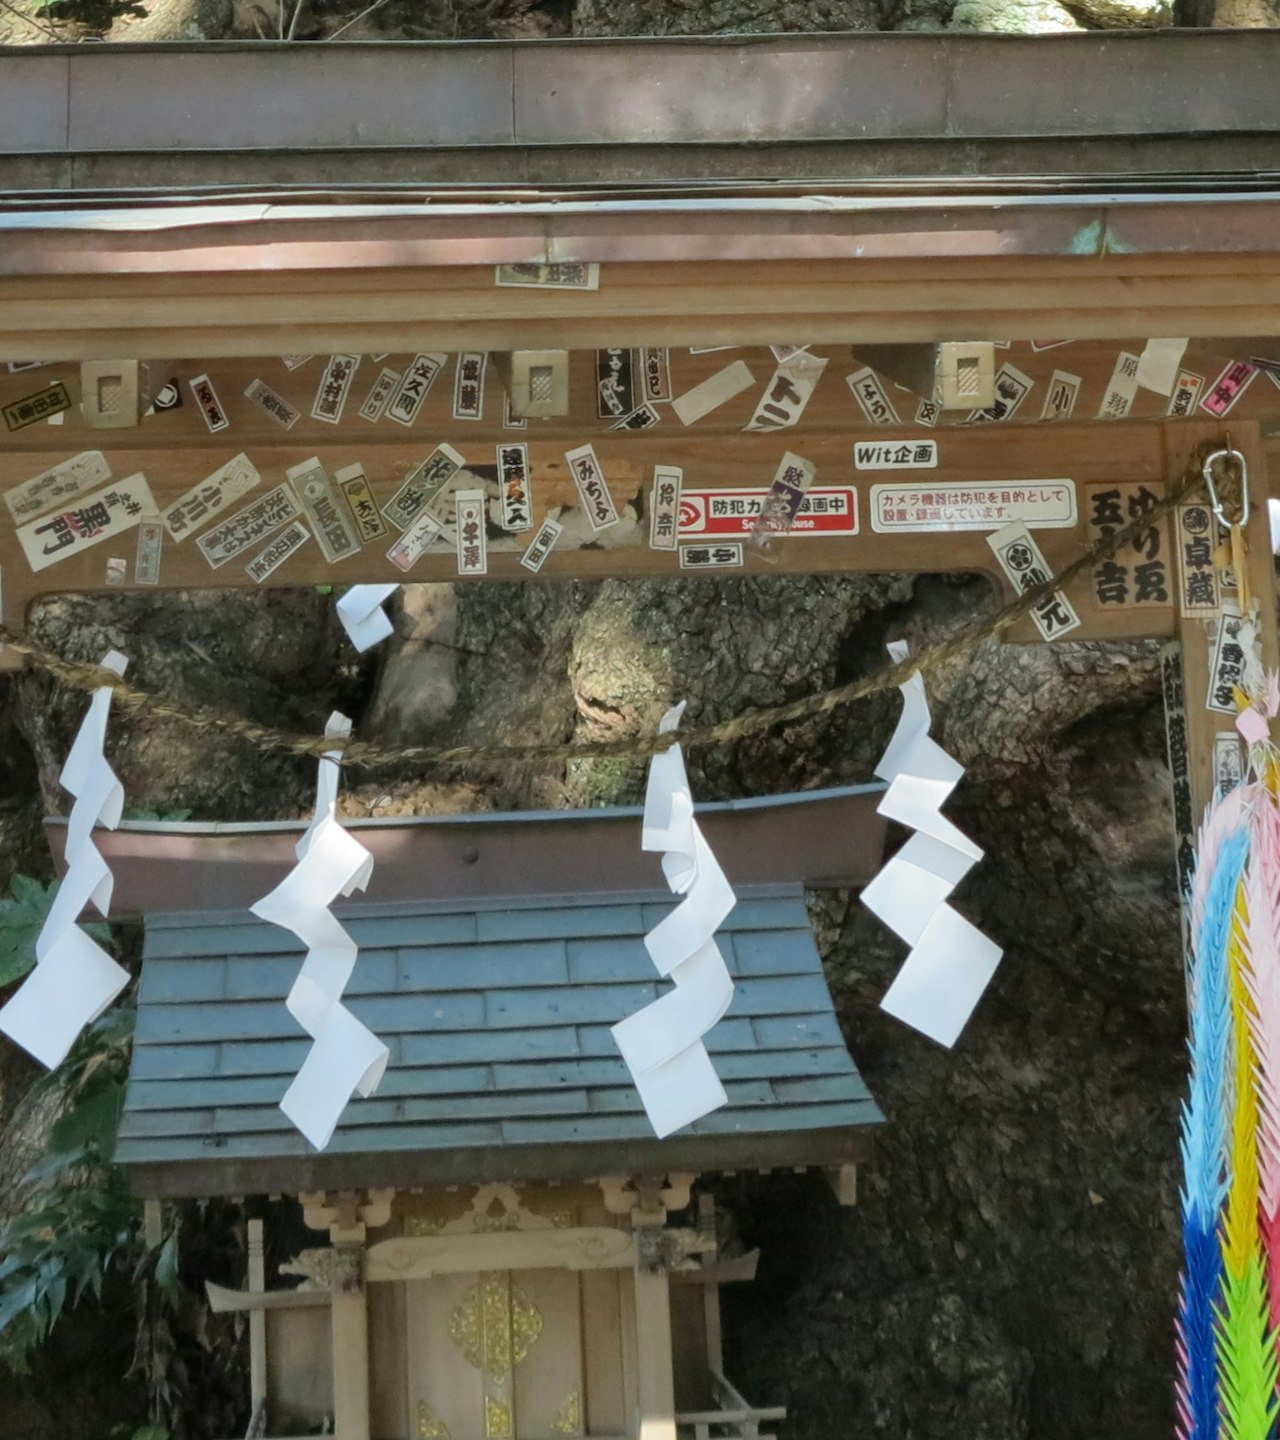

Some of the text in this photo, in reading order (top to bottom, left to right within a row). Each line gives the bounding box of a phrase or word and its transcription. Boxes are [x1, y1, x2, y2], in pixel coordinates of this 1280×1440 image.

[393, 361, 435, 417] 佐久間
[857, 445, 932, 465] Wit企画
[574, 458, 612, 523] みちよ
[882, 489, 1063, 507] カメラ機器は防犯を目的として
[31, 495, 113, 558] 黒門
[1184, 537, 1215, 606] 卓蔵
